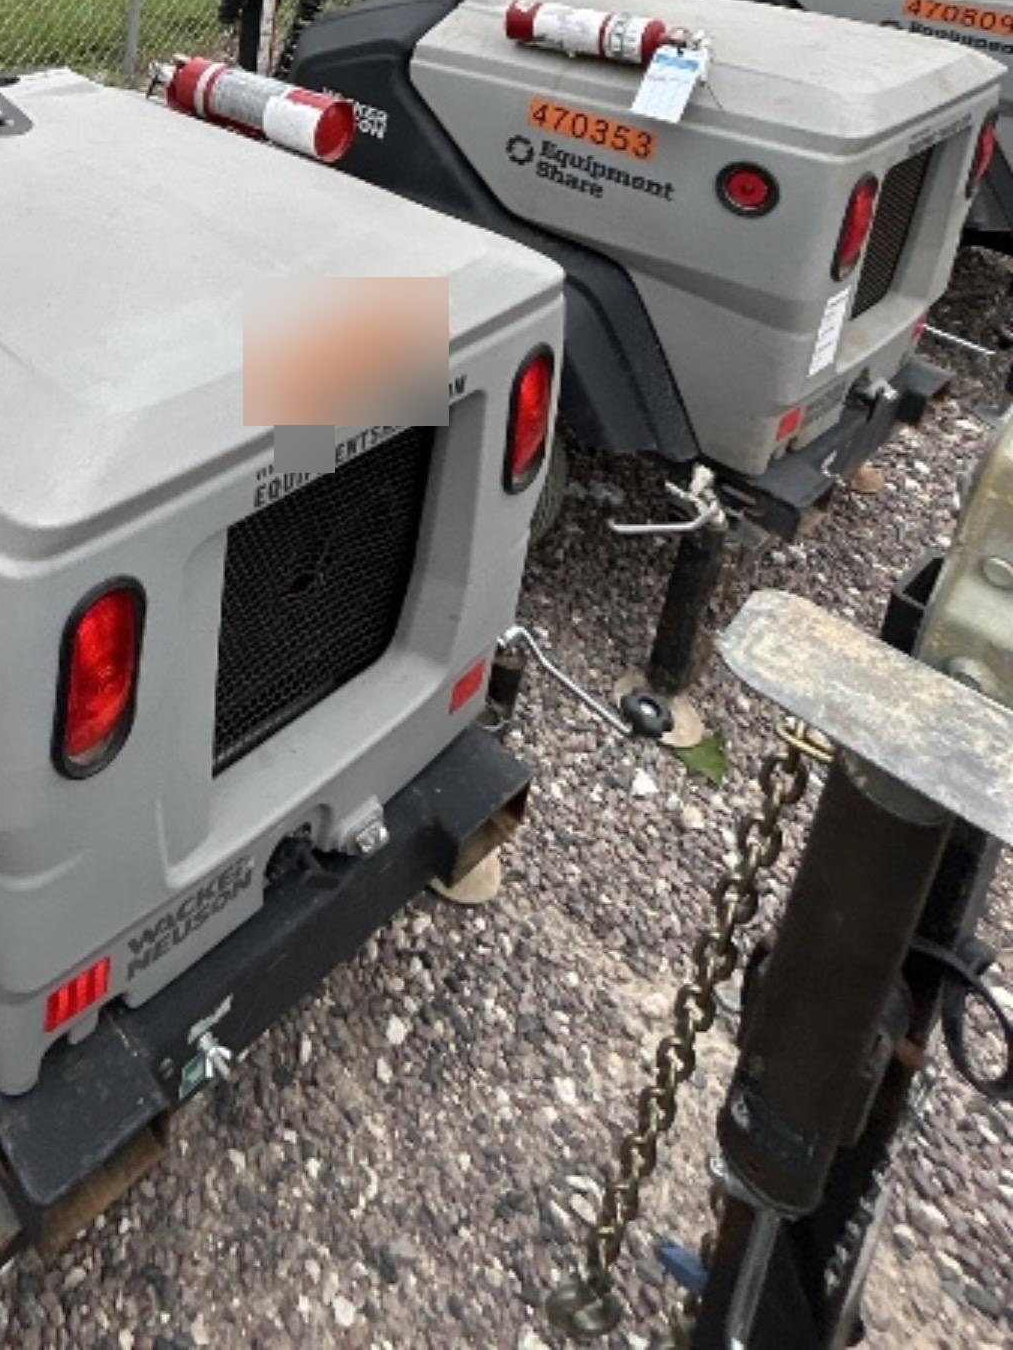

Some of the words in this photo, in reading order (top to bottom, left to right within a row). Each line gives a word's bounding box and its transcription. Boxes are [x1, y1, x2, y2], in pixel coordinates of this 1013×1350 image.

[532, 103, 653, 159] 470353
[536, 160, 604, 199] Share
[539, 140, 675, 200] Equipment
[126, 867, 252, 982] NEUSON
